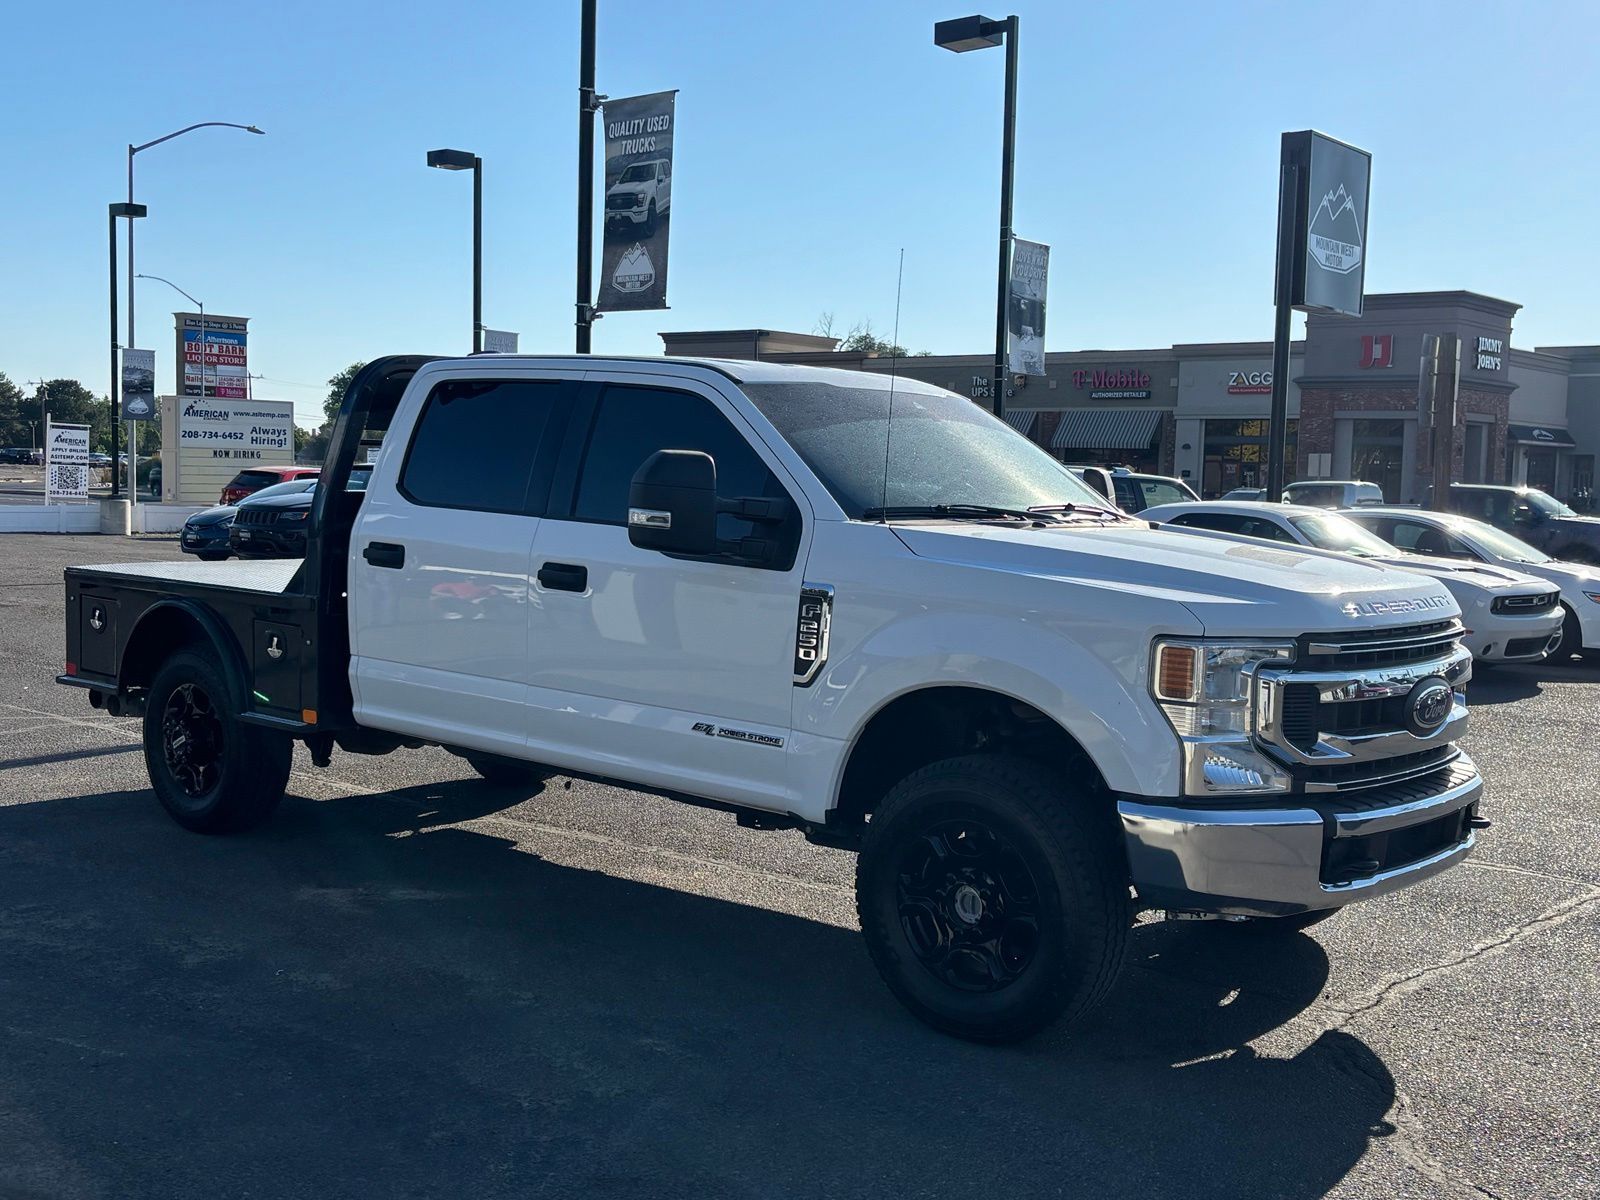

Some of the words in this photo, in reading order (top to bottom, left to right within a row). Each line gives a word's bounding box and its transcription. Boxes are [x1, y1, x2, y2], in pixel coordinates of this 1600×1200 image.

[609, 119, 645, 139] QUALITY
[647, 115, 669, 133] USED
[622, 137, 656, 155] TRUCKS
[1325, 253, 1342, 267] MOTOR
[218, 344, 245, 355] BARN
[1478, 336, 1503, 354] JIMMY
[219, 356, 245, 365] STORE
[1477, 353, 1502, 370] JOHN'S
[972, 376, 988, 386] The
[1229, 371, 1272, 386] ZAGG
[971, 387, 989, 397] UPS
[183, 406, 230, 419] AMERICAN
[233, 411, 290, 419] www.asitemp.com
[181, 430, 244, 440] 208-734-6452
[250, 426, 287, 438] Always
[54, 435, 87, 445] AMERICAN
[250, 436, 287, 448] Hiring!
[213, 449, 230, 459] NOW
[233, 450, 261, 459] HIRING
[718, 728, 747, 740] POWER
[747, 732, 782, 746] STROKE
